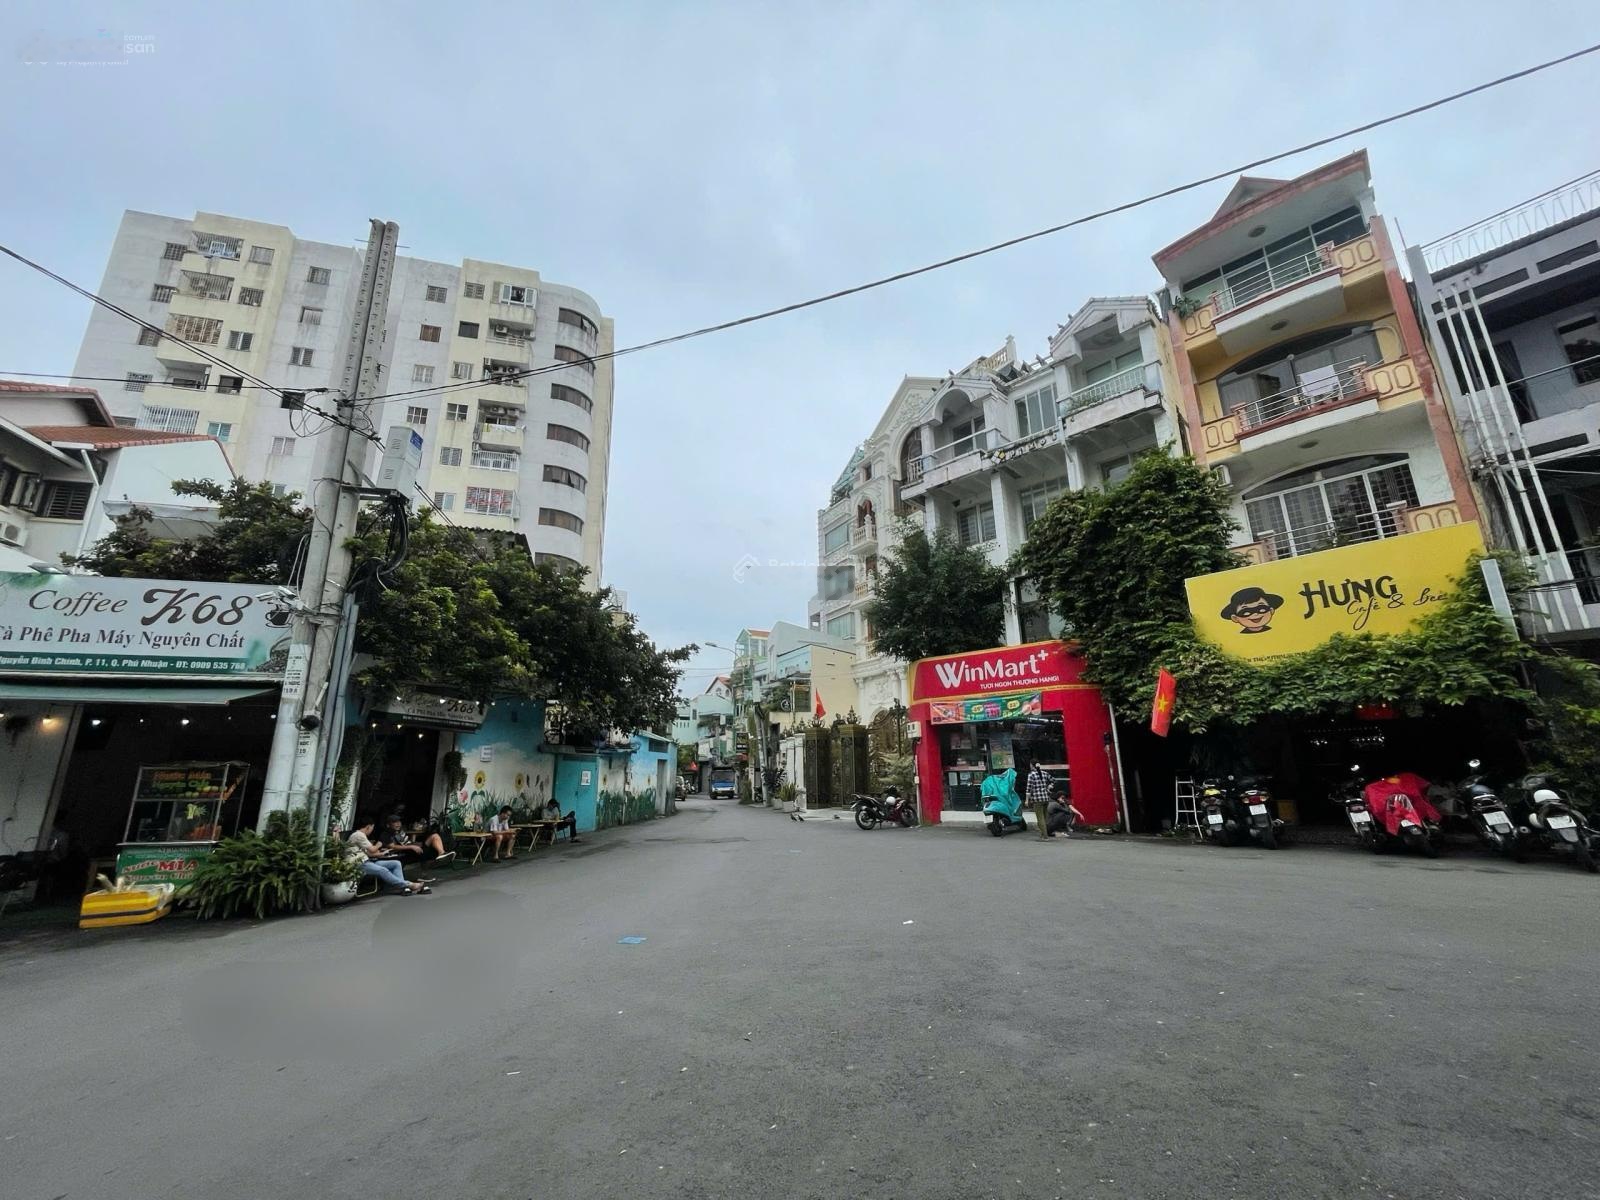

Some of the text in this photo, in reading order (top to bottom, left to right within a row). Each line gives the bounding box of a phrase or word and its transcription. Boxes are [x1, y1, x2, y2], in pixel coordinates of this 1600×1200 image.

[29, 588, 253, 625] Coffee K68
[1298, 575, 1398, 619] HƯNG
[1387, 593, 1405, 608] &
[19, 625, 53, 642] Phê
[58, 627, 91, 643] Pha
[95, 629, 135, 648] Máy
[139, 631, 200, 650] Nguyên
[206, 629, 245, 648] Chất
